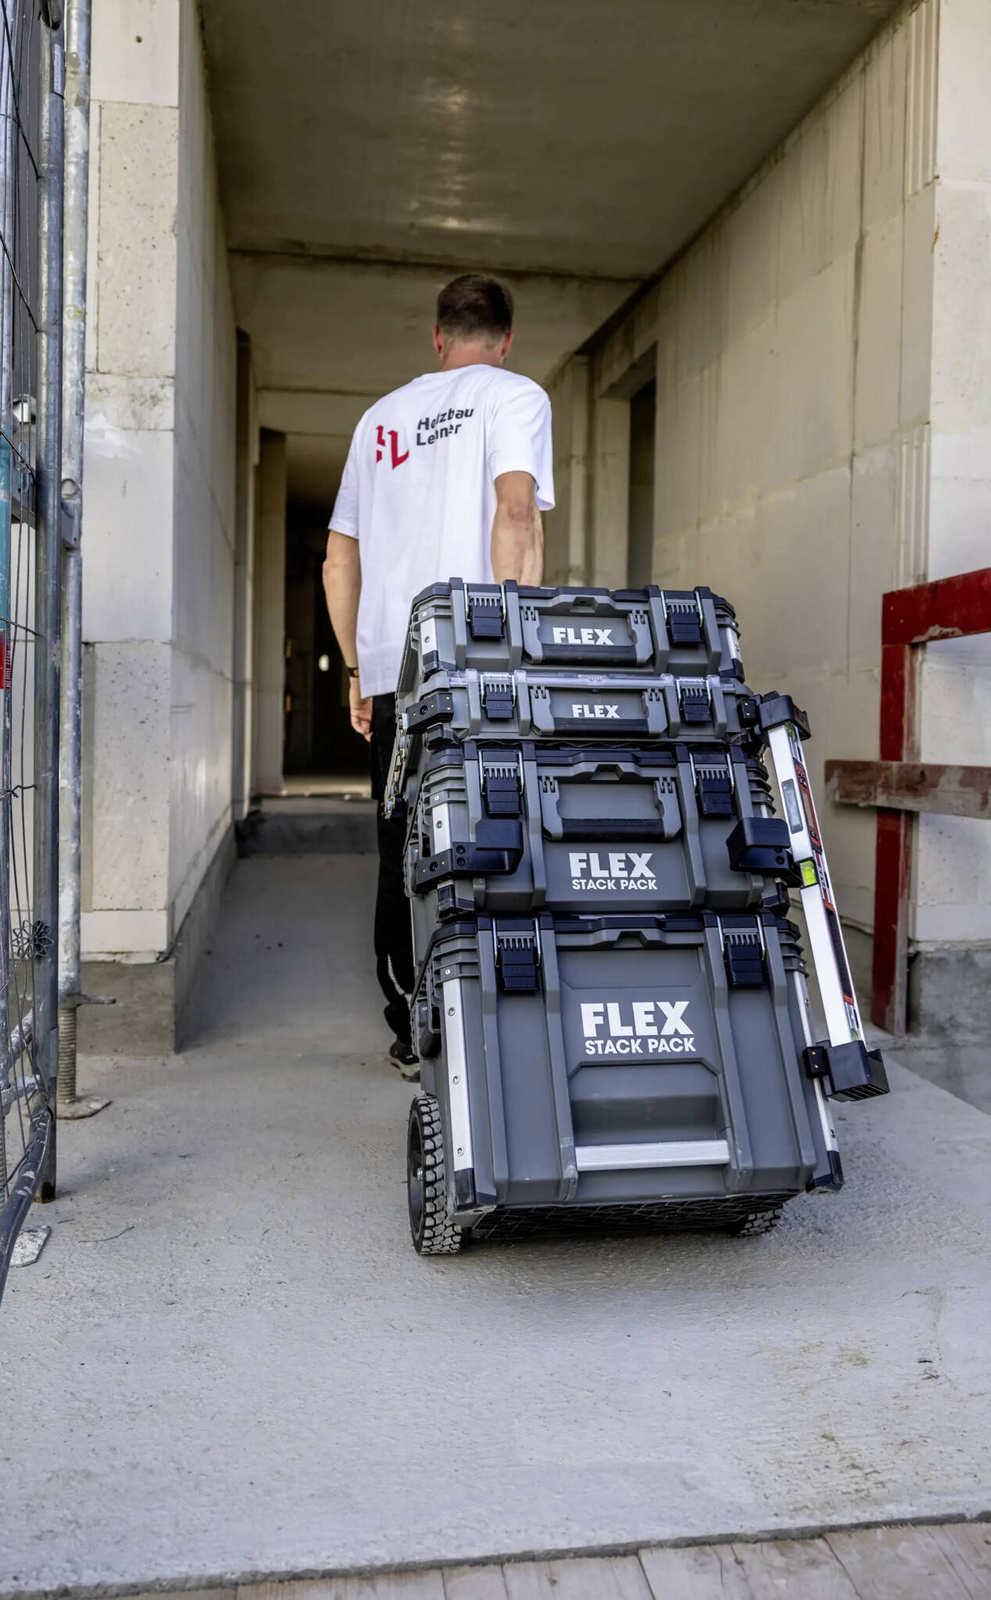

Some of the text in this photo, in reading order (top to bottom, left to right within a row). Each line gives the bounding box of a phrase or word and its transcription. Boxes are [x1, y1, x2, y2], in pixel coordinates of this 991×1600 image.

[417, 407, 475, 431] Holzbau
[552, 627, 614, 646] FLEX
[572, 704, 621, 719] FLEX
[569, 852, 657, 878] FLEX
[572, 879, 658, 891] STACK PACK
[580, 1001, 695, 1038] FLEX
[585, 1037, 697, 1055] STACK PACK
